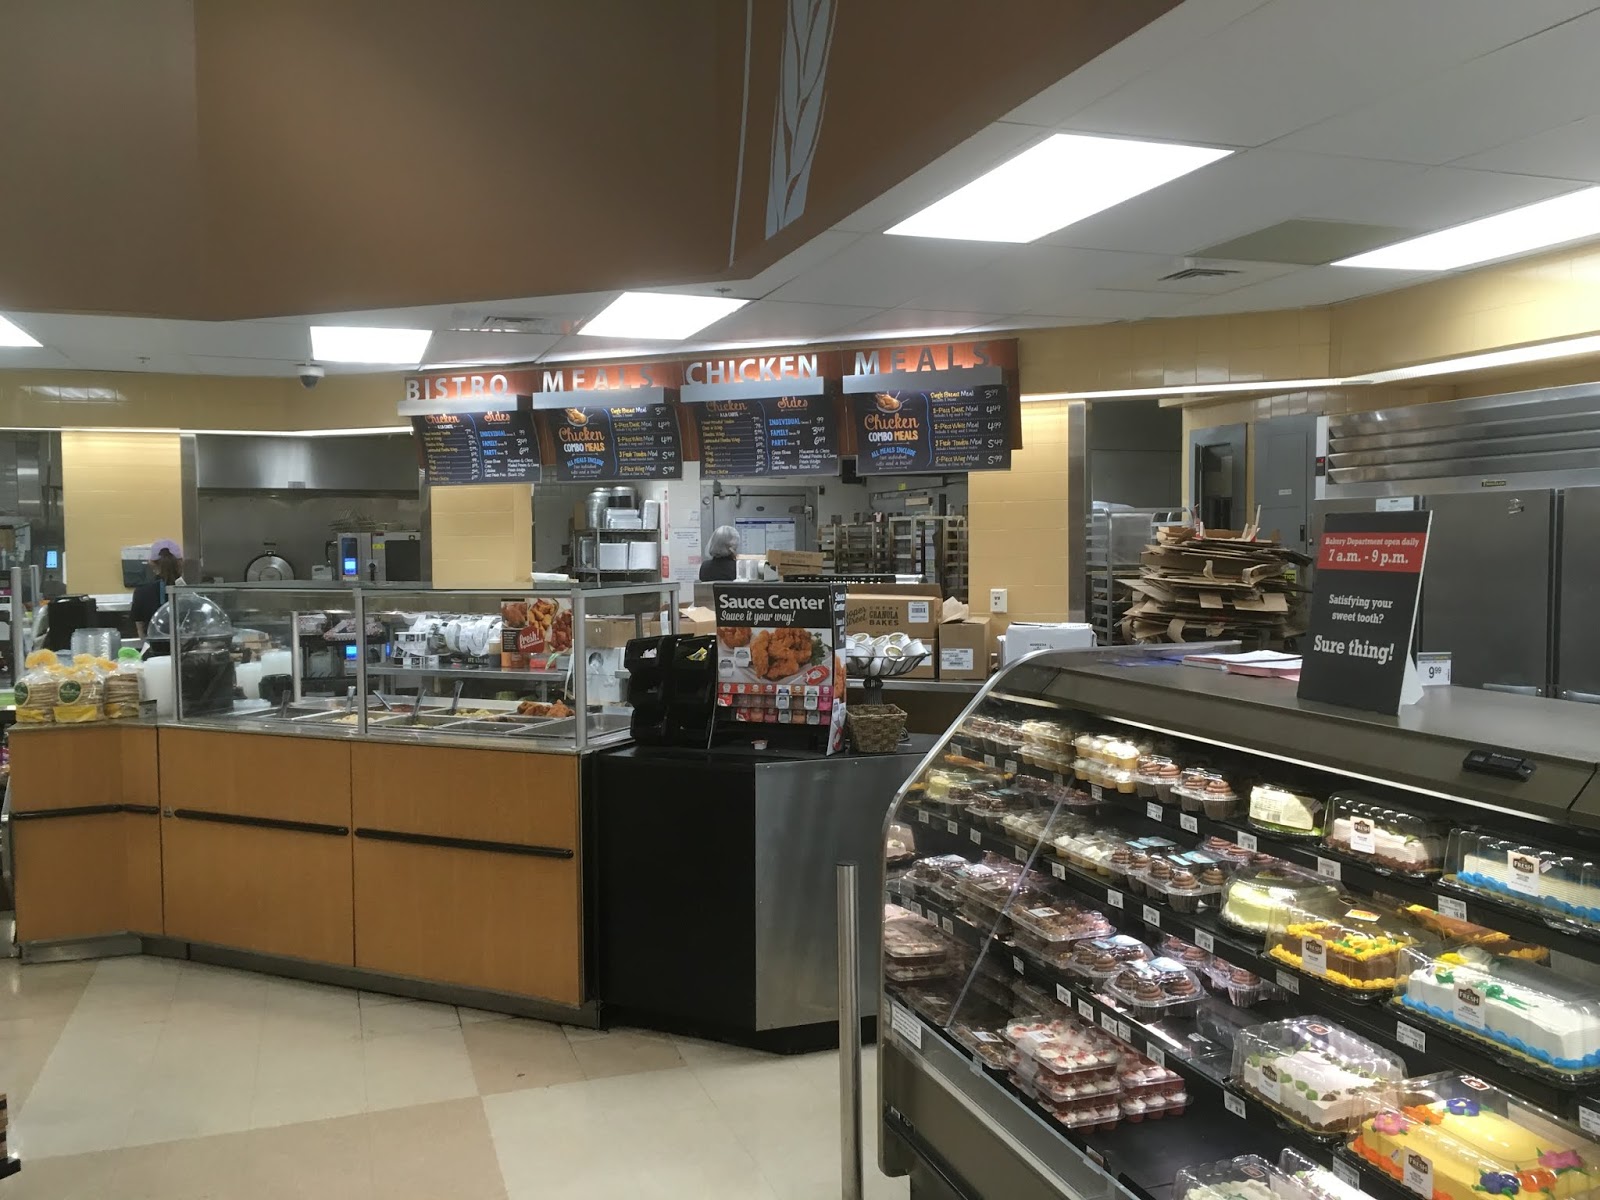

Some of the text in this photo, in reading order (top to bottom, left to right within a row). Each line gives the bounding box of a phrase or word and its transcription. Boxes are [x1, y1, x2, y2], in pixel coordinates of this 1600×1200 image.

[685, 342, 991, 385] CHICKEN MEALS
[405, 366, 654, 401] BISTRO MEALS
[706, 400, 747, 412] Chicken
[777, 396, 808, 408] Sides
[425, 414, 460, 424] Chicken
[484, 411, 510, 422] Sides
[864, 413, 919, 430] Chicken
[559, 426, 605, 442] Chicken
[868, 430, 918, 442] COMBO MEALS
[564, 442, 605, 452] COMBO MEALS
[871, 447, 916, 458] ALL MEALS INCLUDE
[1325, 537, 1419, 547] Bakery Department open daily
[1328, 549, 1335, 561] 7
[1336, 552, 1361, 562] a.m.
[1372, 550, 1378, 563] 9
[1380, 552, 1408, 566] p.m.
[719, 594, 824, 610] Sauce Center
[1329, 595, 1393, 609] Satisfying your
[720, 610, 796, 625] Sauce it your way!
[869, 611, 899, 619] GRANOLA
[1332, 611, 1384, 624] sweet tooth?
[1314, 635, 1394, 664] Sure thing!
[1514, 860, 1533, 871] FRESH
[1459, 991, 1479, 1003] FRESH
[1410, 1158, 1428, 1172] FRESH
